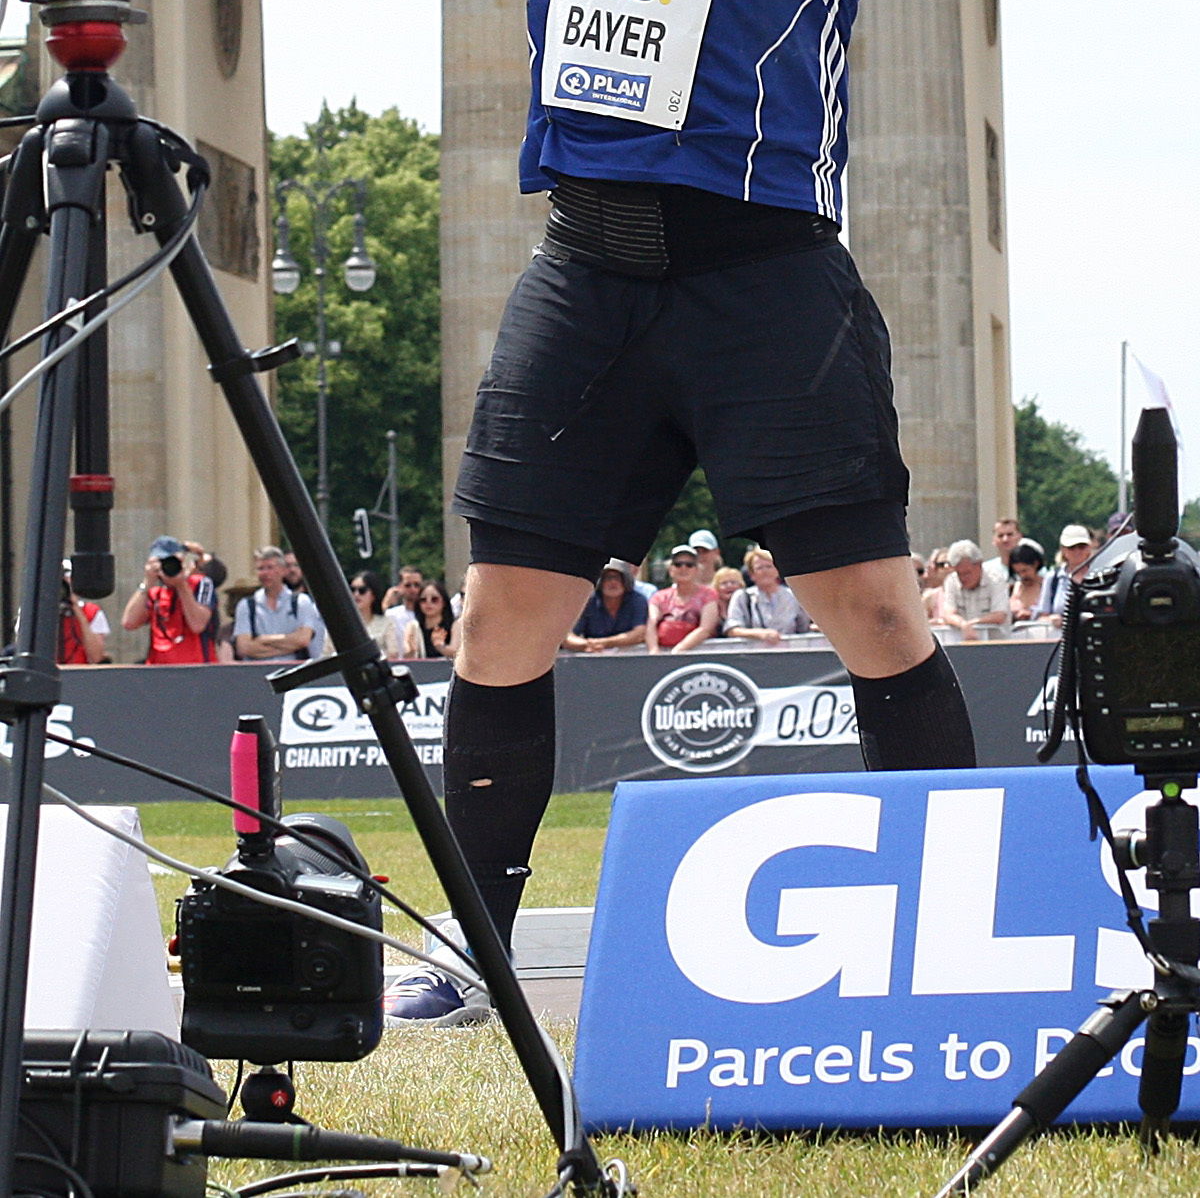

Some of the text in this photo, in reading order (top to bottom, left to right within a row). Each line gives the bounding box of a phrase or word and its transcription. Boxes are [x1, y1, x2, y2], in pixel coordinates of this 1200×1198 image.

[563, 5, 666, 62] BAYER
[593, 74, 645, 99] PLAN
[668, 89, 682, 112] 730
[655, 701, 755, 732] Warsteiner
[285, 745, 443, 768] CHARITY-PAER
[665, 1031, 914, 1089] Parcels
[939, 1033, 1011, 1079] to
